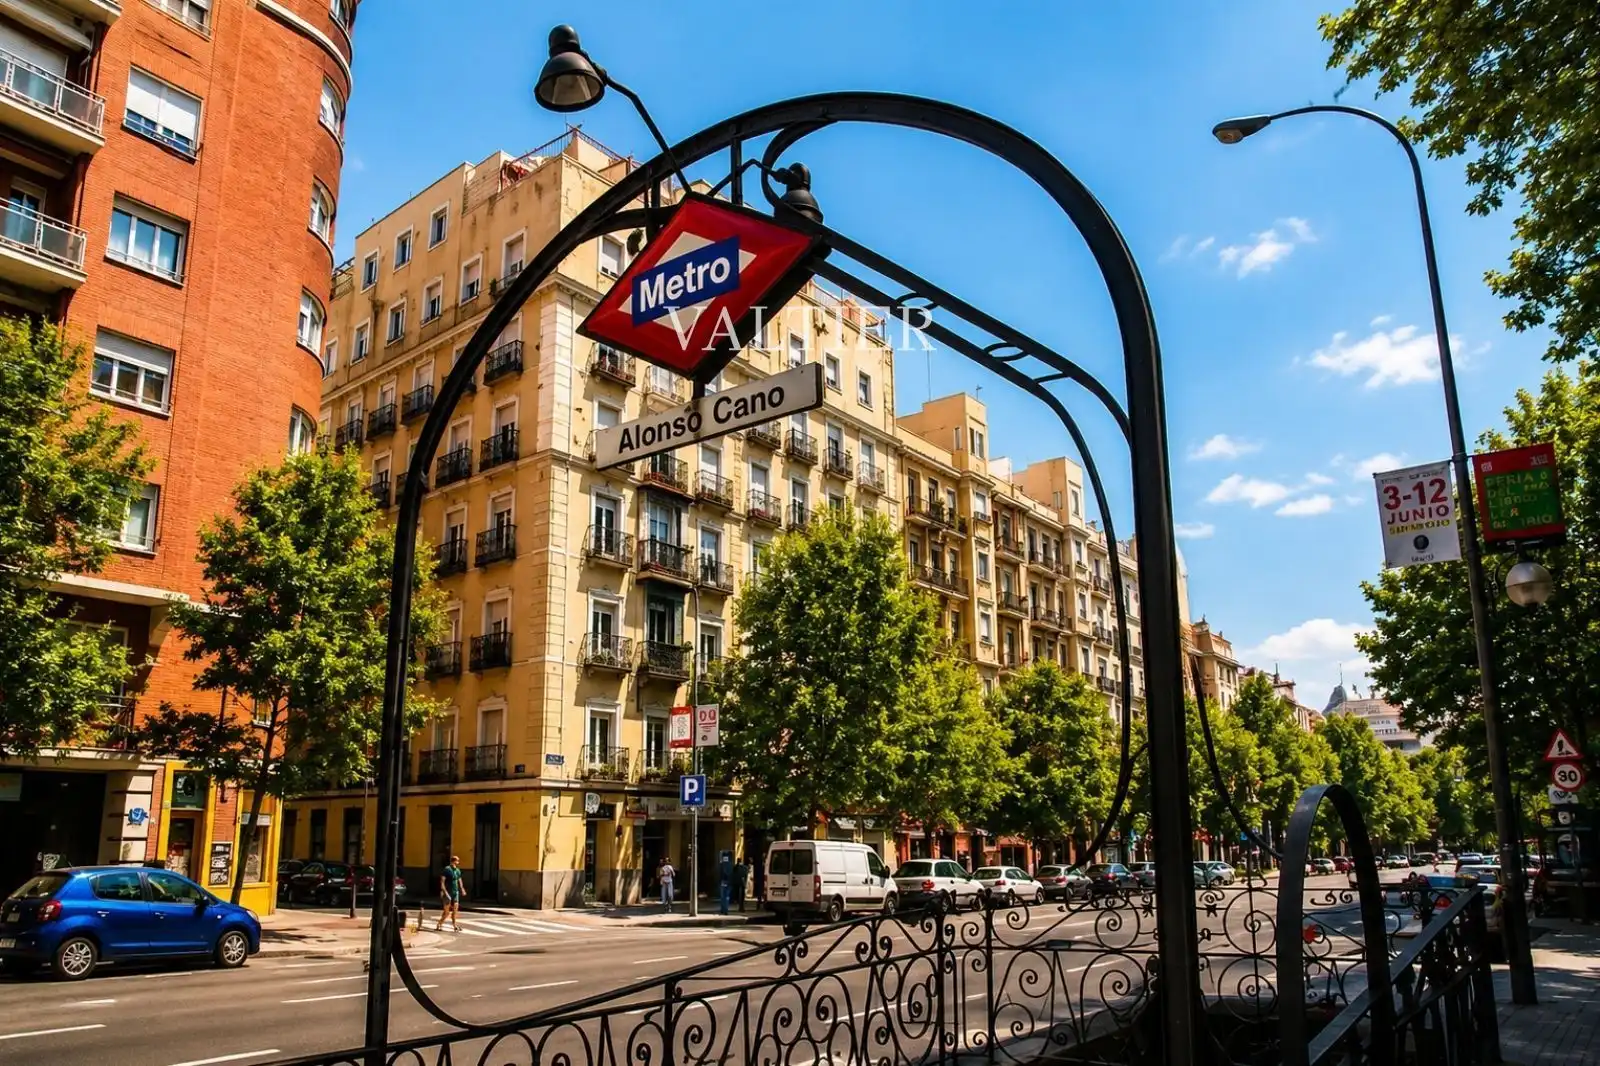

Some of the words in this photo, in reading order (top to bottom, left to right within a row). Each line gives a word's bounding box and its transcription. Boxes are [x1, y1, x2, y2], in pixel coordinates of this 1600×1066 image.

[639, 256, 731, 313] Metro
[618, 410, 702, 455] Alonso
[712, 385, 785, 425] Cano
[1383, 478, 1448, 510] 3-12
[1387, 504, 1450, 525] JUNIO
[684, 778, 698, 801] P
[1558, 770, 1577, 782] 30
